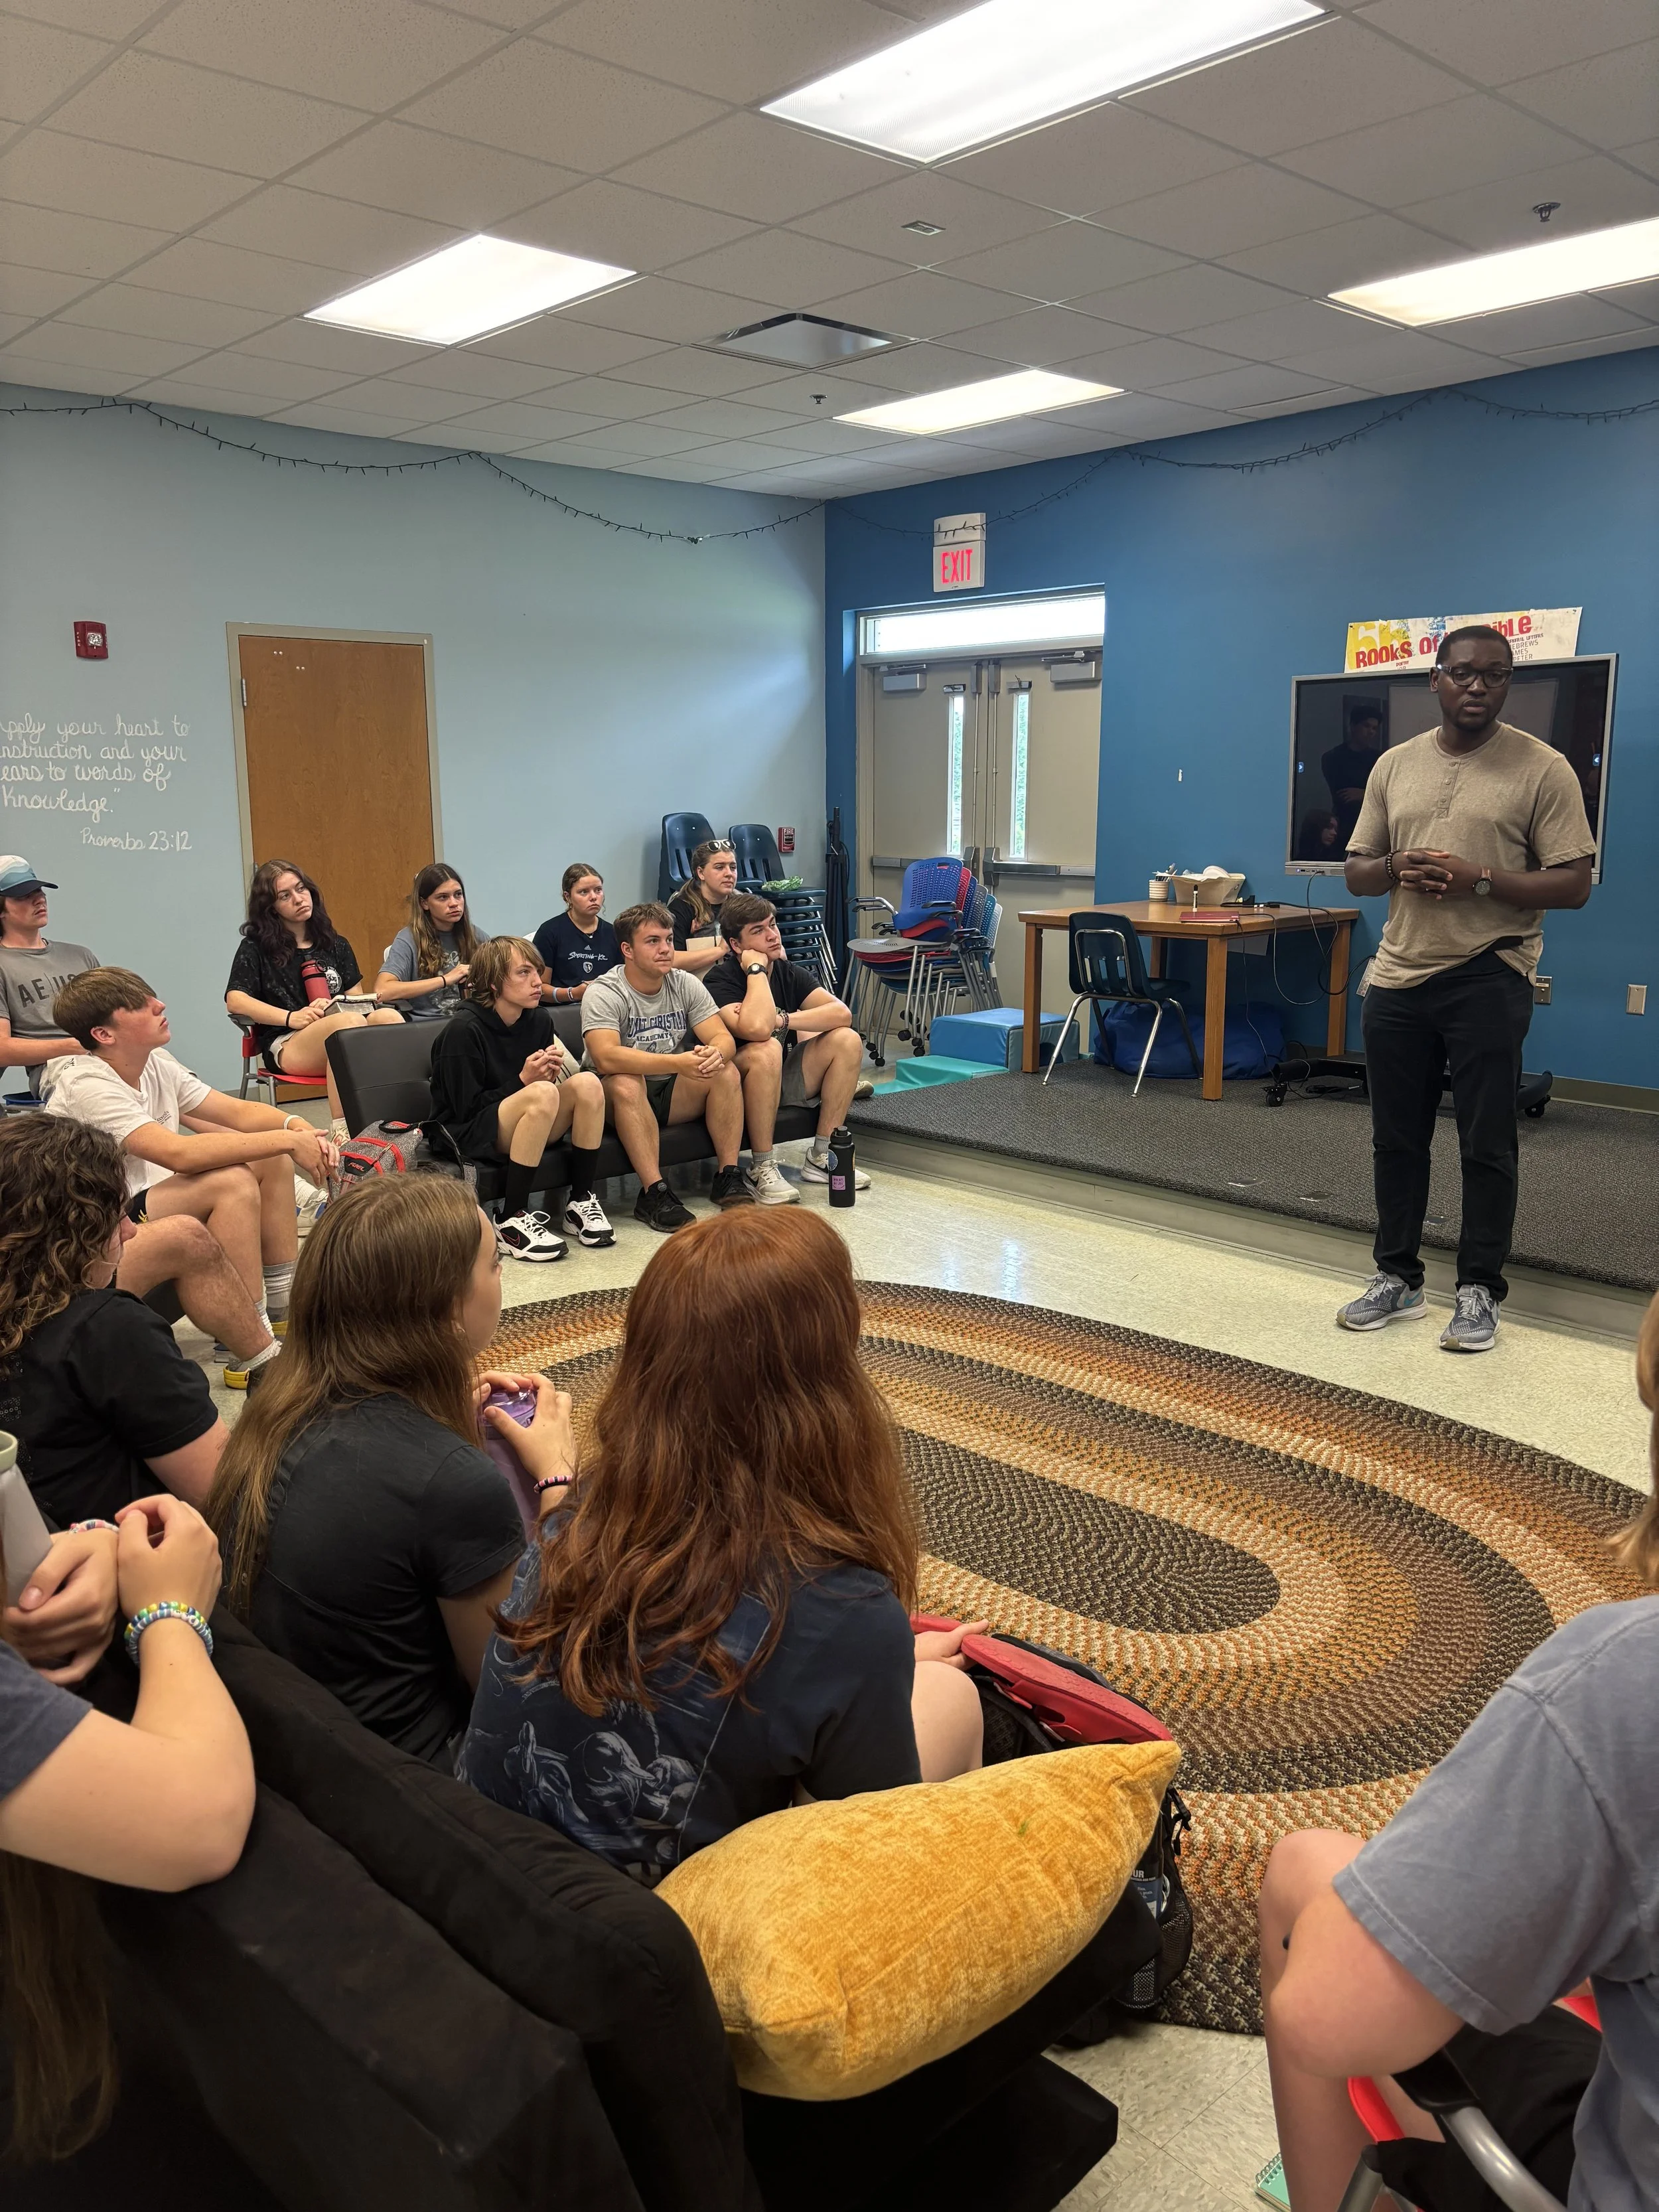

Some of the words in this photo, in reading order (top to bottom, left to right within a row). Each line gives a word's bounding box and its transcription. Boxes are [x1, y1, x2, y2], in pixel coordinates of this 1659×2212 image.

[941, 549, 973, 584] EXIT
[57, 722, 106, 743] your
[114, 713, 163, 737] heart
[171, 714, 190, 737] to
[0, 739, 92, 760] nstruction
[100, 739, 135, 760] and
[141, 745, 186, 768] your
[0, 765, 44, 782] ears
[44, 761, 67, 782] to
[74, 763, 135, 782] words
[142, 763, 171, 791] of
[80, 828, 145, 850] Proverbs
[149, 830, 192, 851] 23:12
[1130, 1869, 1145, 1878] UR
